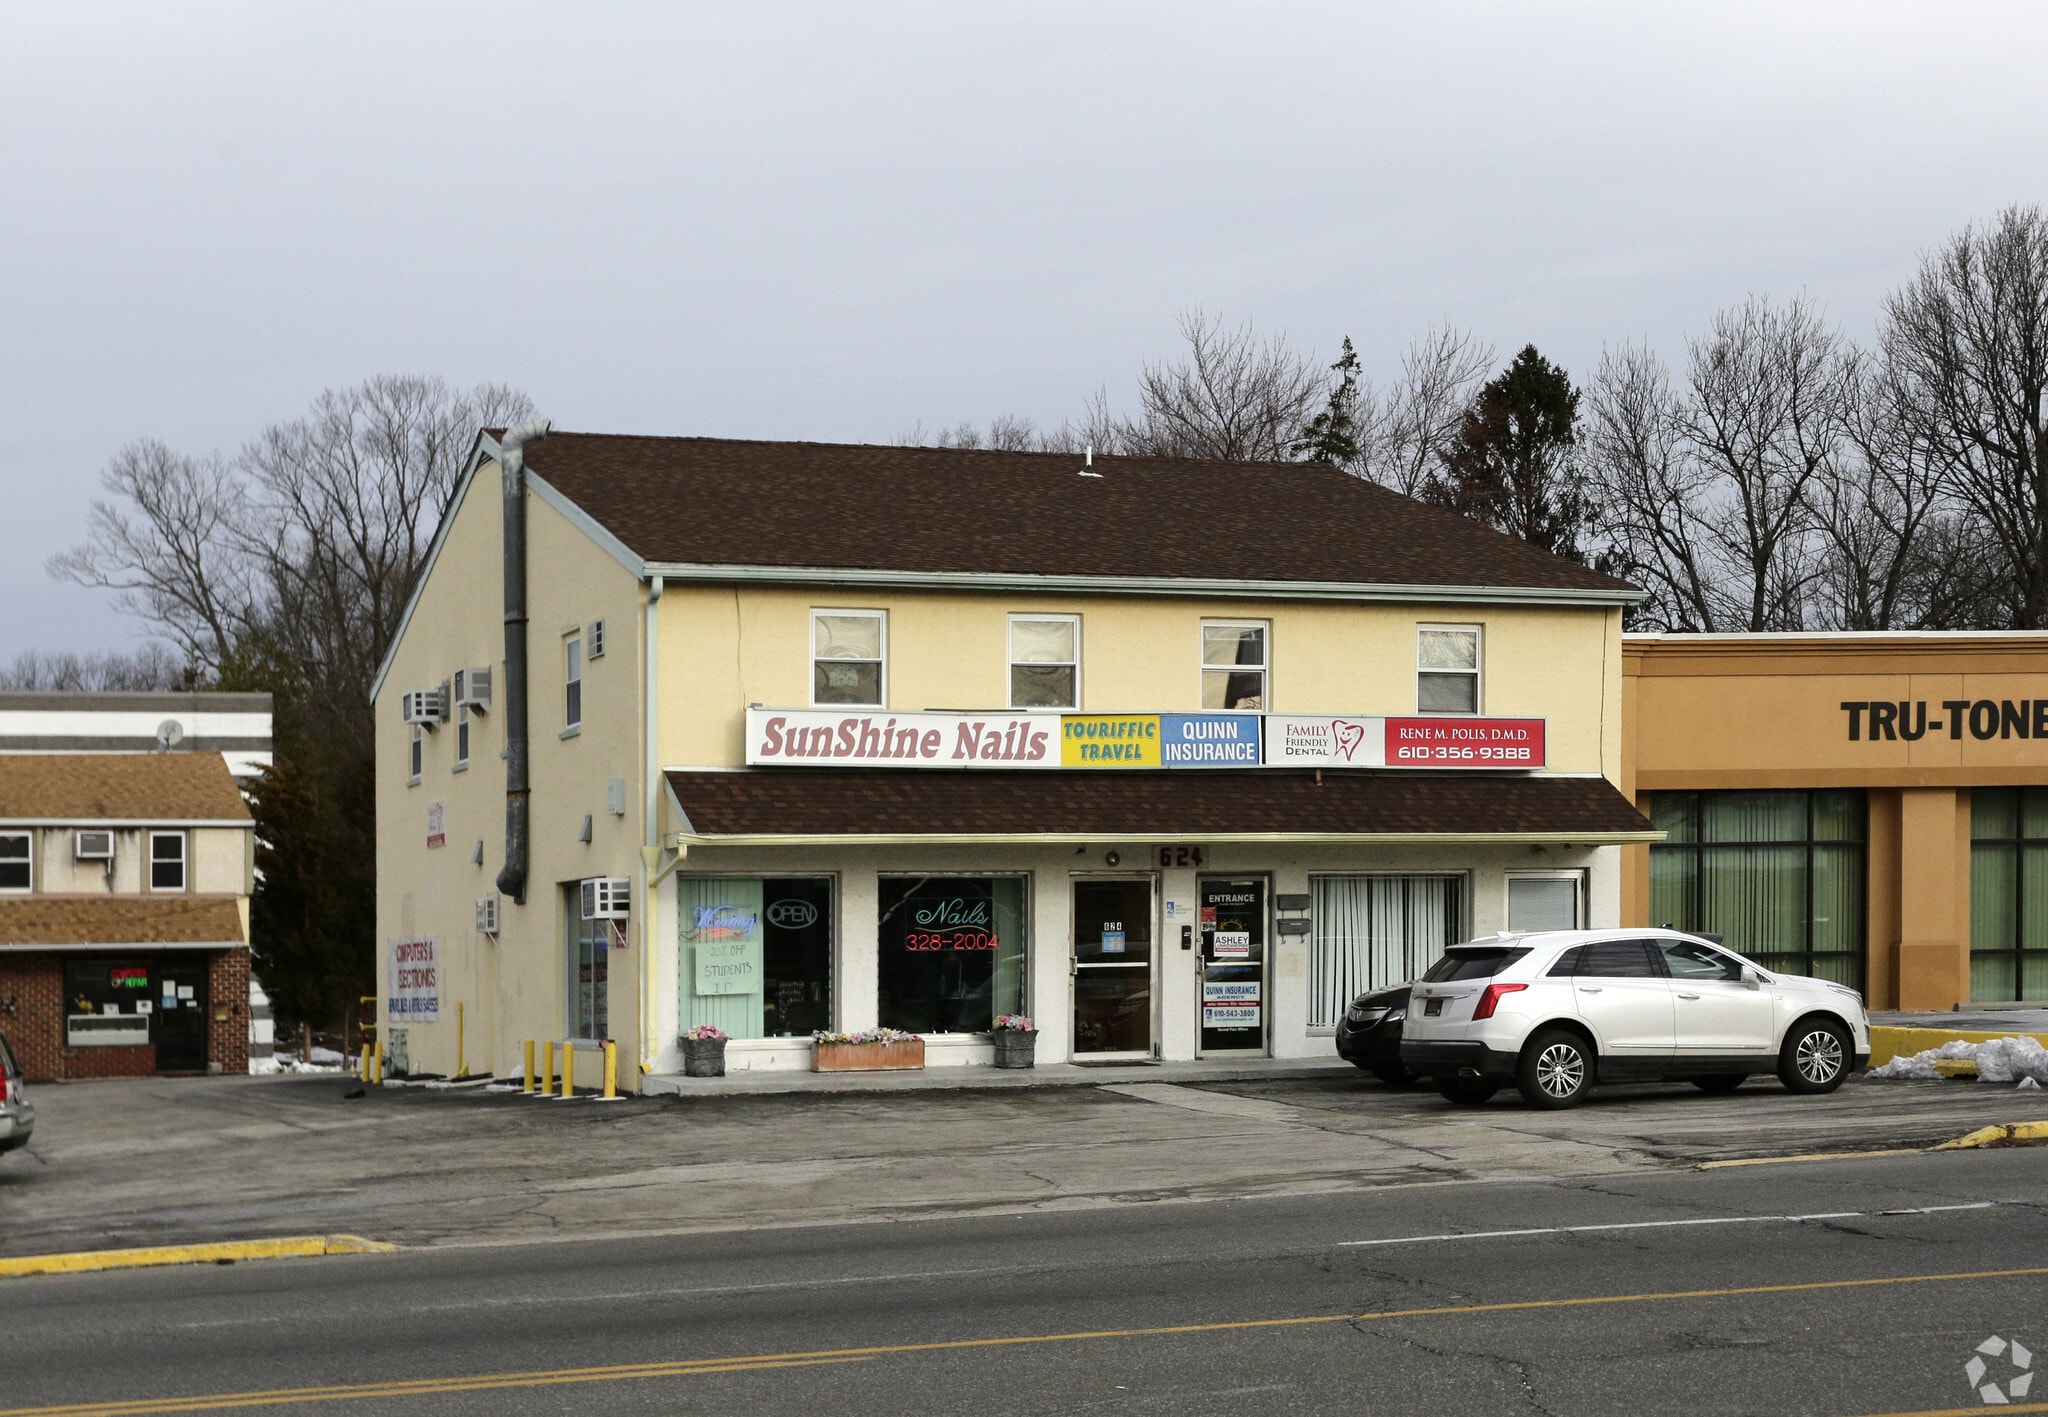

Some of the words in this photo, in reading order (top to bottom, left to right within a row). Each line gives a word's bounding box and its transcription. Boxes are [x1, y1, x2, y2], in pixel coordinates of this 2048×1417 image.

[1840, 699, 2048, 742] TRU-TONE
[760, 717, 941, 759] SunShine
[951, 721, 1049, 761] Nails
[1064, 721, 1156, 740] TOURIFFIC
[1182, 721, 1238, 740] QUINN
[1285, 723, 1329, 737] FAMILY
[1399, 728, 1432, 740] RENE
[1434, 729, 1448, 740] M.
[1451, 728, 1489, 741] POLIS,
[1491, 729, 1530, 741] D.M.D.
[1285, 737, 1329, 748] FRIENDLY
[1285, 747, 1330, 756] DENTAL
[1080, 743, 1143, 762] TRAVEL
[1165, 743, 1256, 762] INSURANCE
[1160, 846, 1203, 867] 624
[1208, 894, 1255, 903] ENTRANCE
[770, 905, 814, 923] OPEN
[915, 898, 989, 925] Nails
[906, 933, 999, 951] 328-2004
[1215, 936, 1249, 944] ASHLEY
[710, 945, 728, 957] 20%
[730, 944, 746, 957] OFF
[704, 961, 753, 977] STUDENTS
[1205, 986, 1223, 995] QUINN
[1225, 985, 1257, 995] INSURANCE
